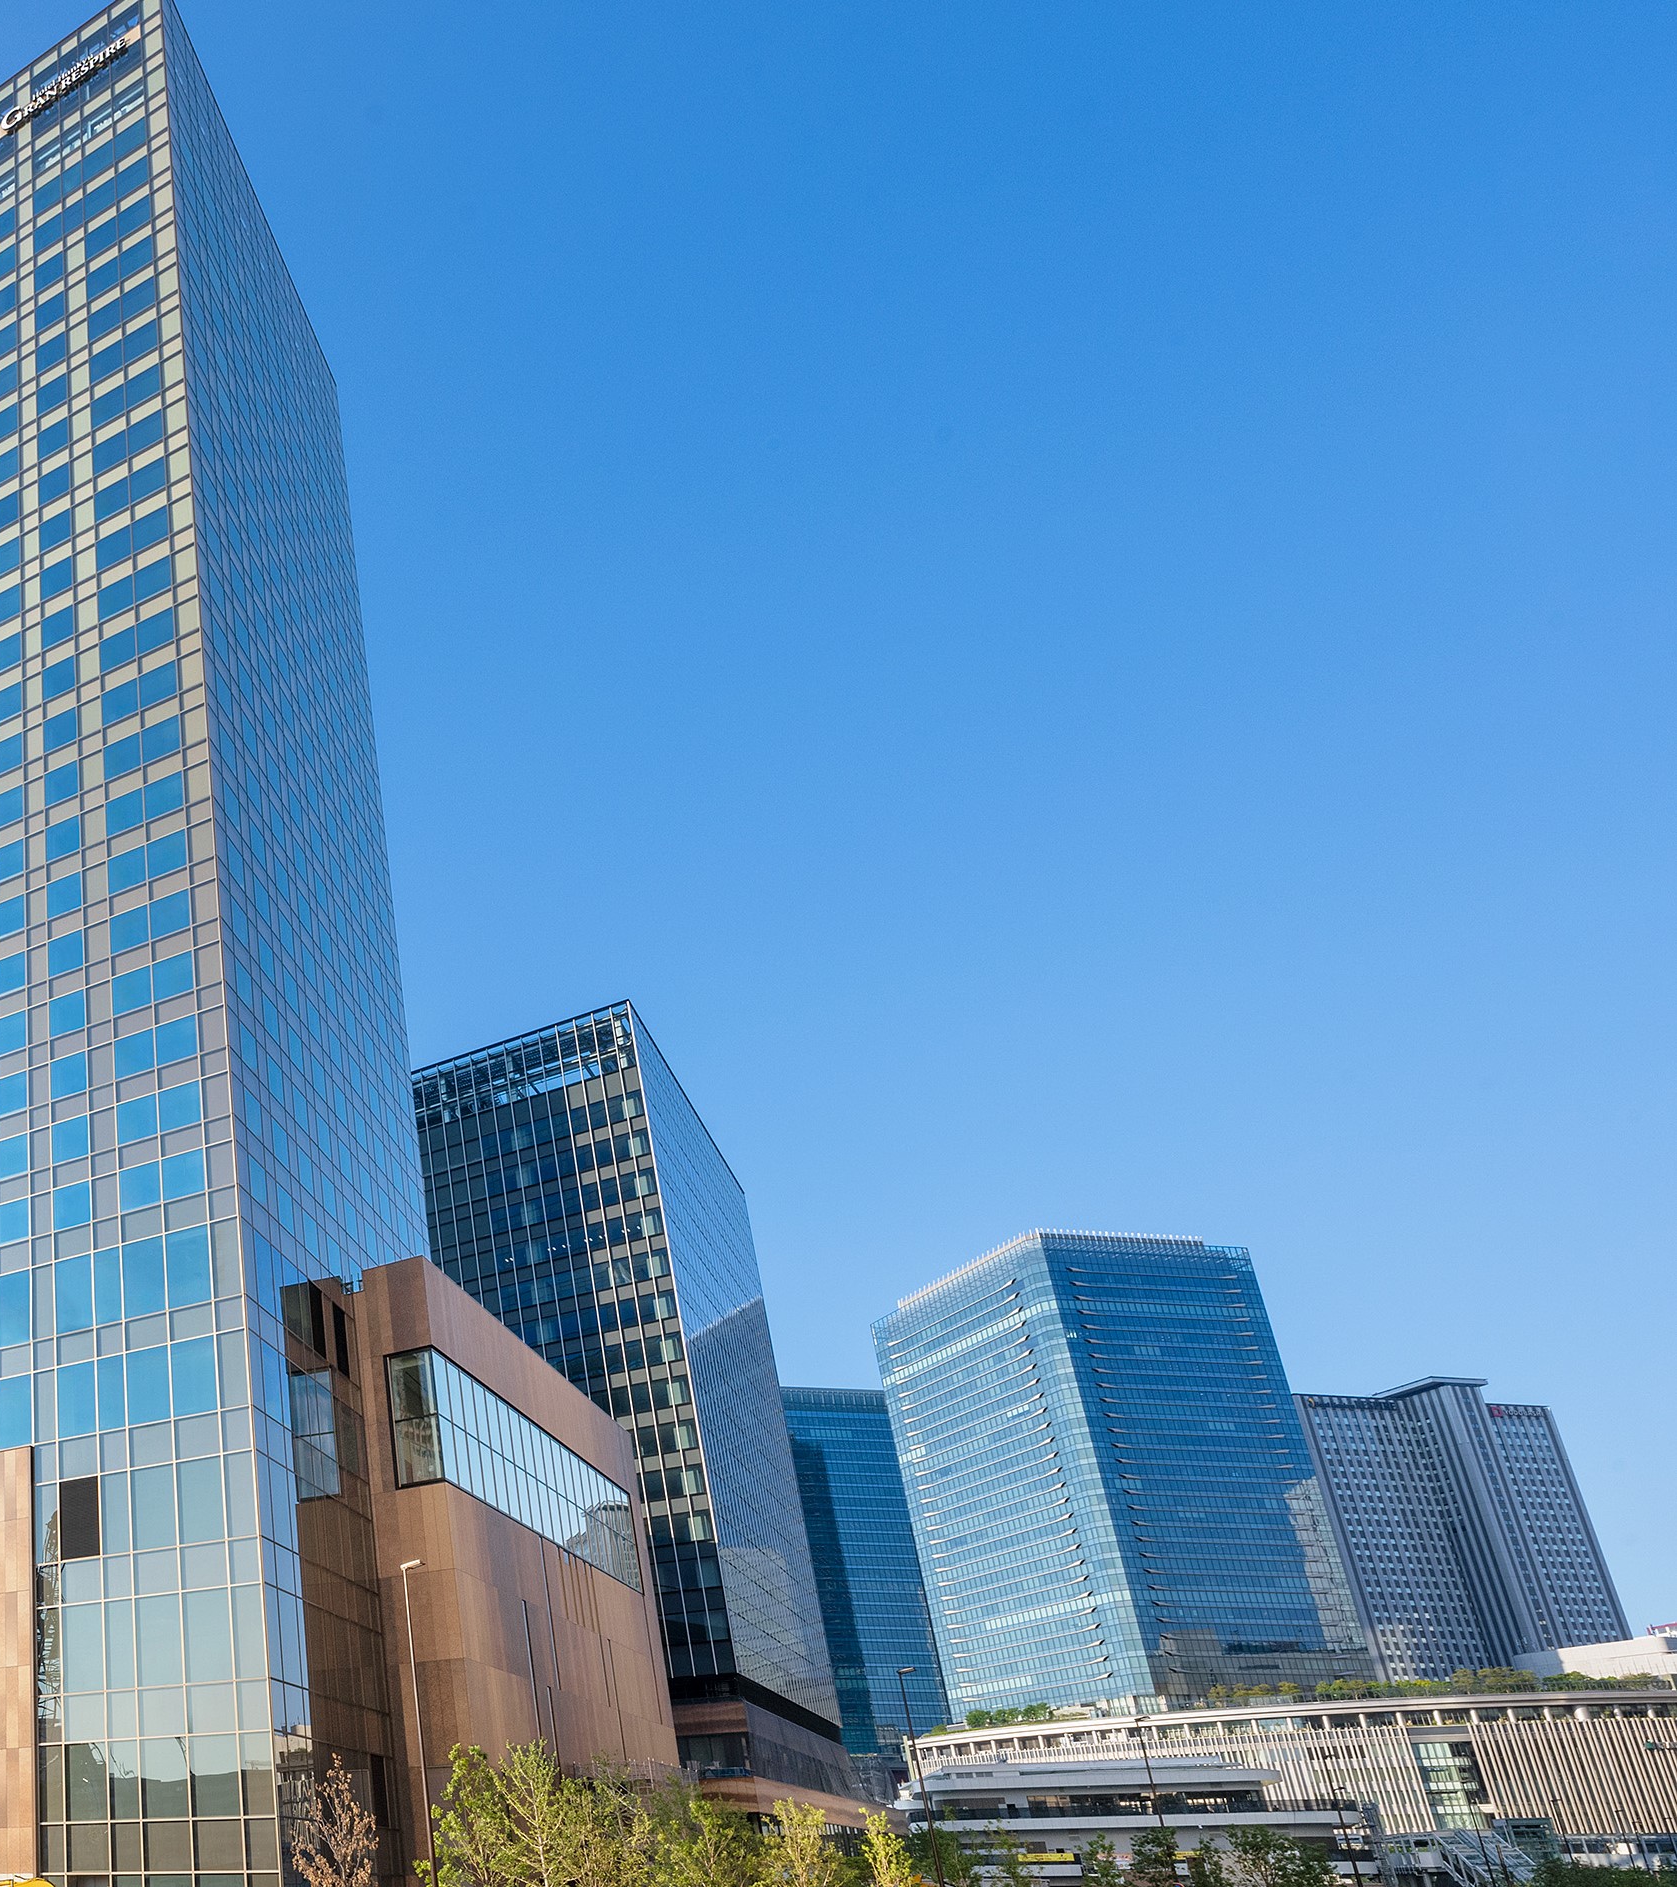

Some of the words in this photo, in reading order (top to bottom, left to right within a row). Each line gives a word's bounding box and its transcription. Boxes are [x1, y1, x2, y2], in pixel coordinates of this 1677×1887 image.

[0, 84, 59, 130] GRAN
[60, 36, 126, 90] RESPIRE
[32, 79, 55, 100] Hotel
